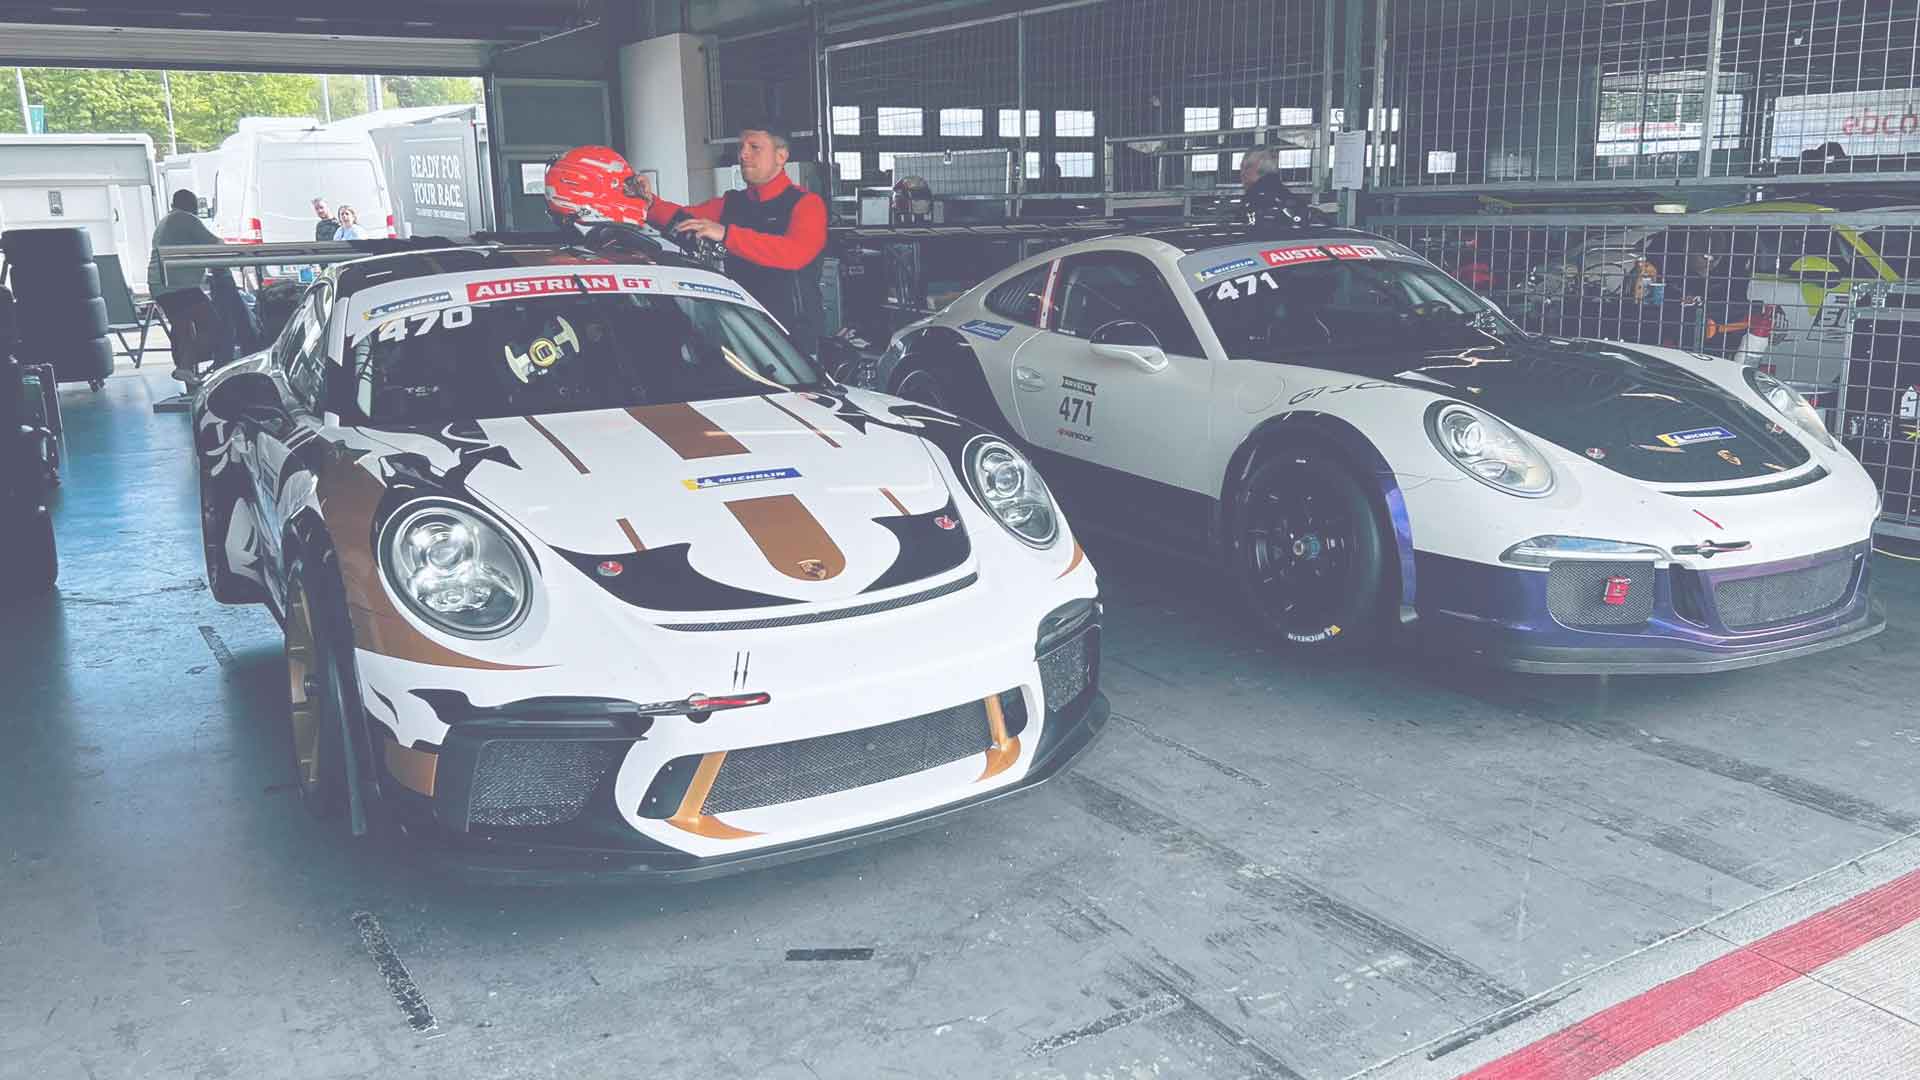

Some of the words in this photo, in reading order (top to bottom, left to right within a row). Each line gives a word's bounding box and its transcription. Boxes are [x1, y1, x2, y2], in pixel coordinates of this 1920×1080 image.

[409, 154, 440, 178] READY
[440, 155, 462, 178] FOR
[412, 182, 437, 205] YOUR
[622, 278, 653, 288] GT
[1216, 271, 1279, 300] 471
[388, 294, 449, 312] MICHELIN
[378, 305, 473, 341] 470
[1059, 396, 1092, 427] 471
[1682, 430, 1722, 440] MICHELIN
[719, 471, 786, 483] MICHELIN
[1287, 632, 1325, 642] MICHELIN
